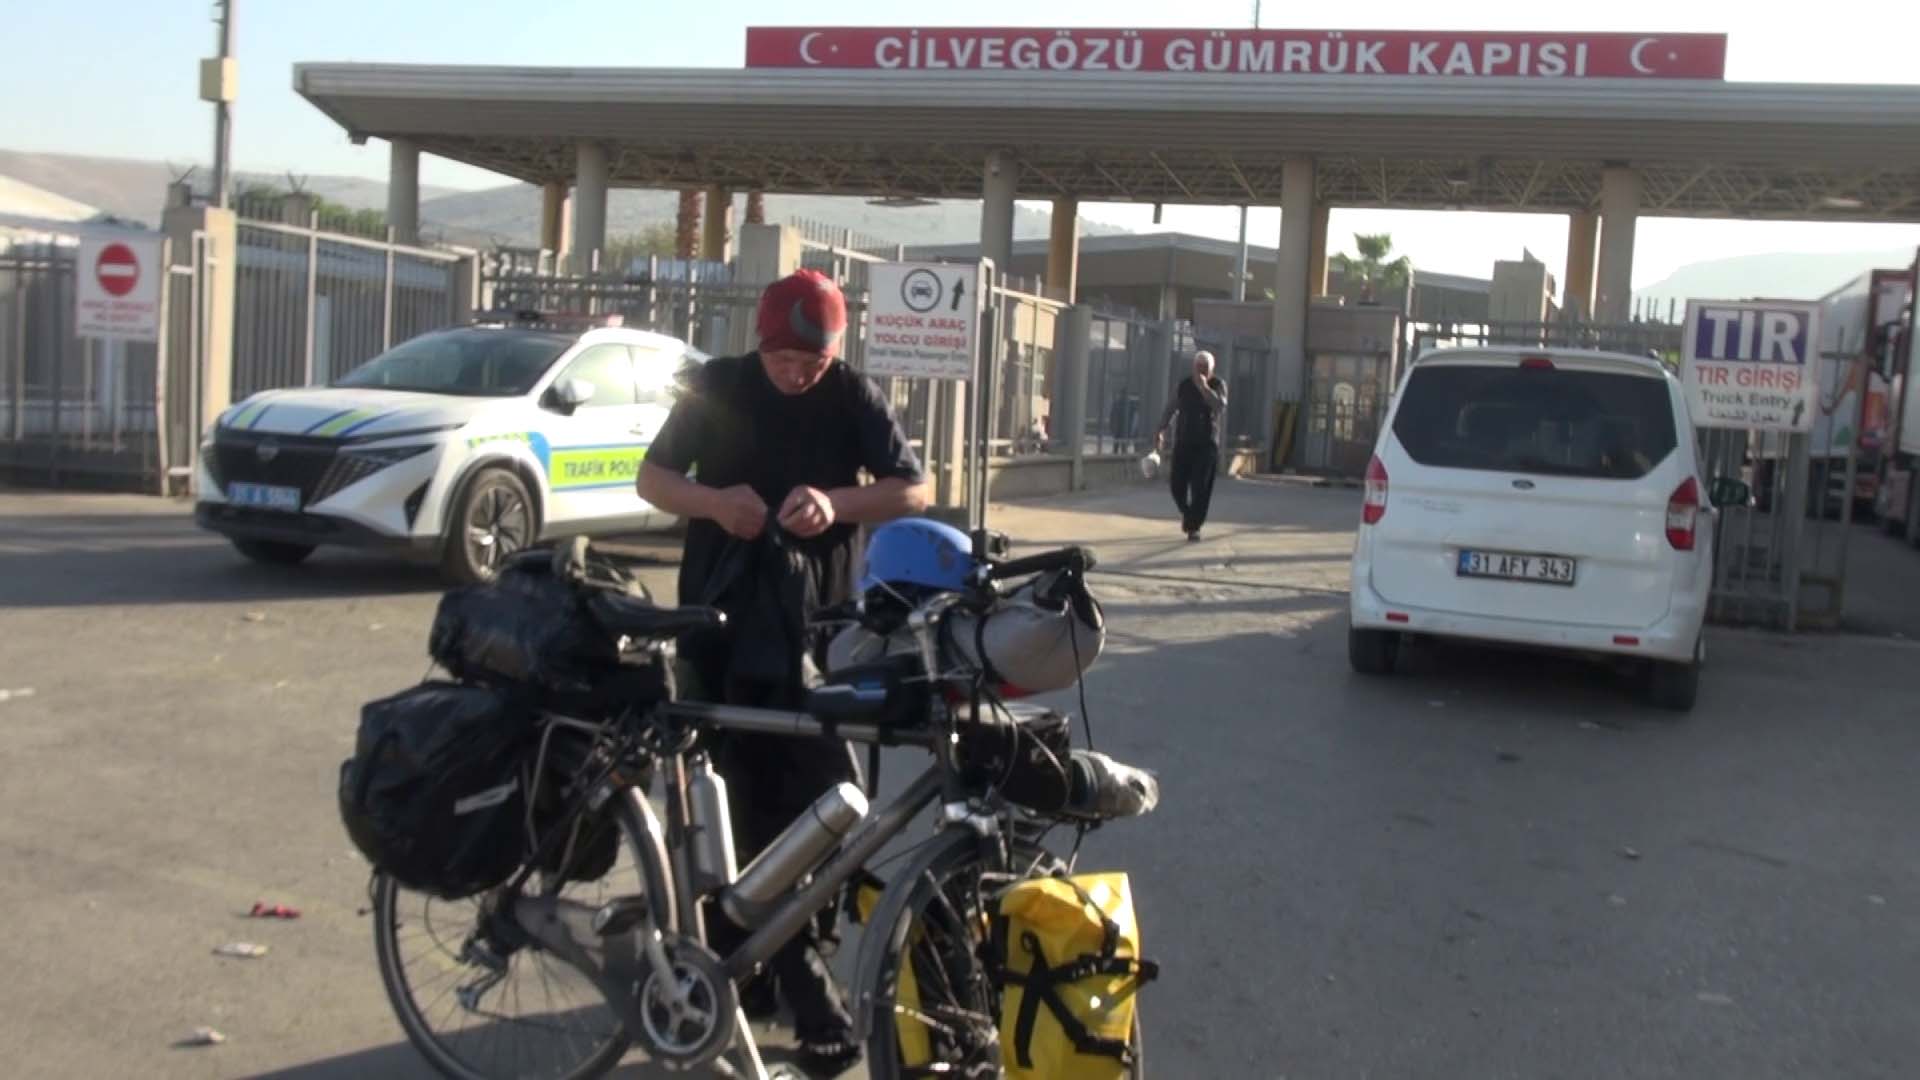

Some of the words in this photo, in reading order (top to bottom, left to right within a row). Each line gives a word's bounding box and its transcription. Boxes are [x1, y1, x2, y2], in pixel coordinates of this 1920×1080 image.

[875, 29, 1144, 71] CİLVEGÖZÜ
[1164, 31, 1387, 74] GÜMRÜK
[1407, 40, 1588, 77] KAPISI
[875, 314, 922, 329] KÜÇÜK
[928, 318, 966, 332] ARAÇ
[875, 332, 919, 345] YOLCU
[1704, 309, 1799, 363] TIR
[1696, 365, 1728, 385] TIR
[1736, 364, 1802, 393] GİRİŞİ
[1701, 389, 1743, 405] Truck
[1748, 391, 1792, 410] Entry
[564, 459, 605, 478] TRAFİK
[609, 456, 639, 477] POLİ
[1471, 554, 1489, 573] 31
[1499, 556, 1531, 577] AFY
[1539, 559, 1571, 581] 343
